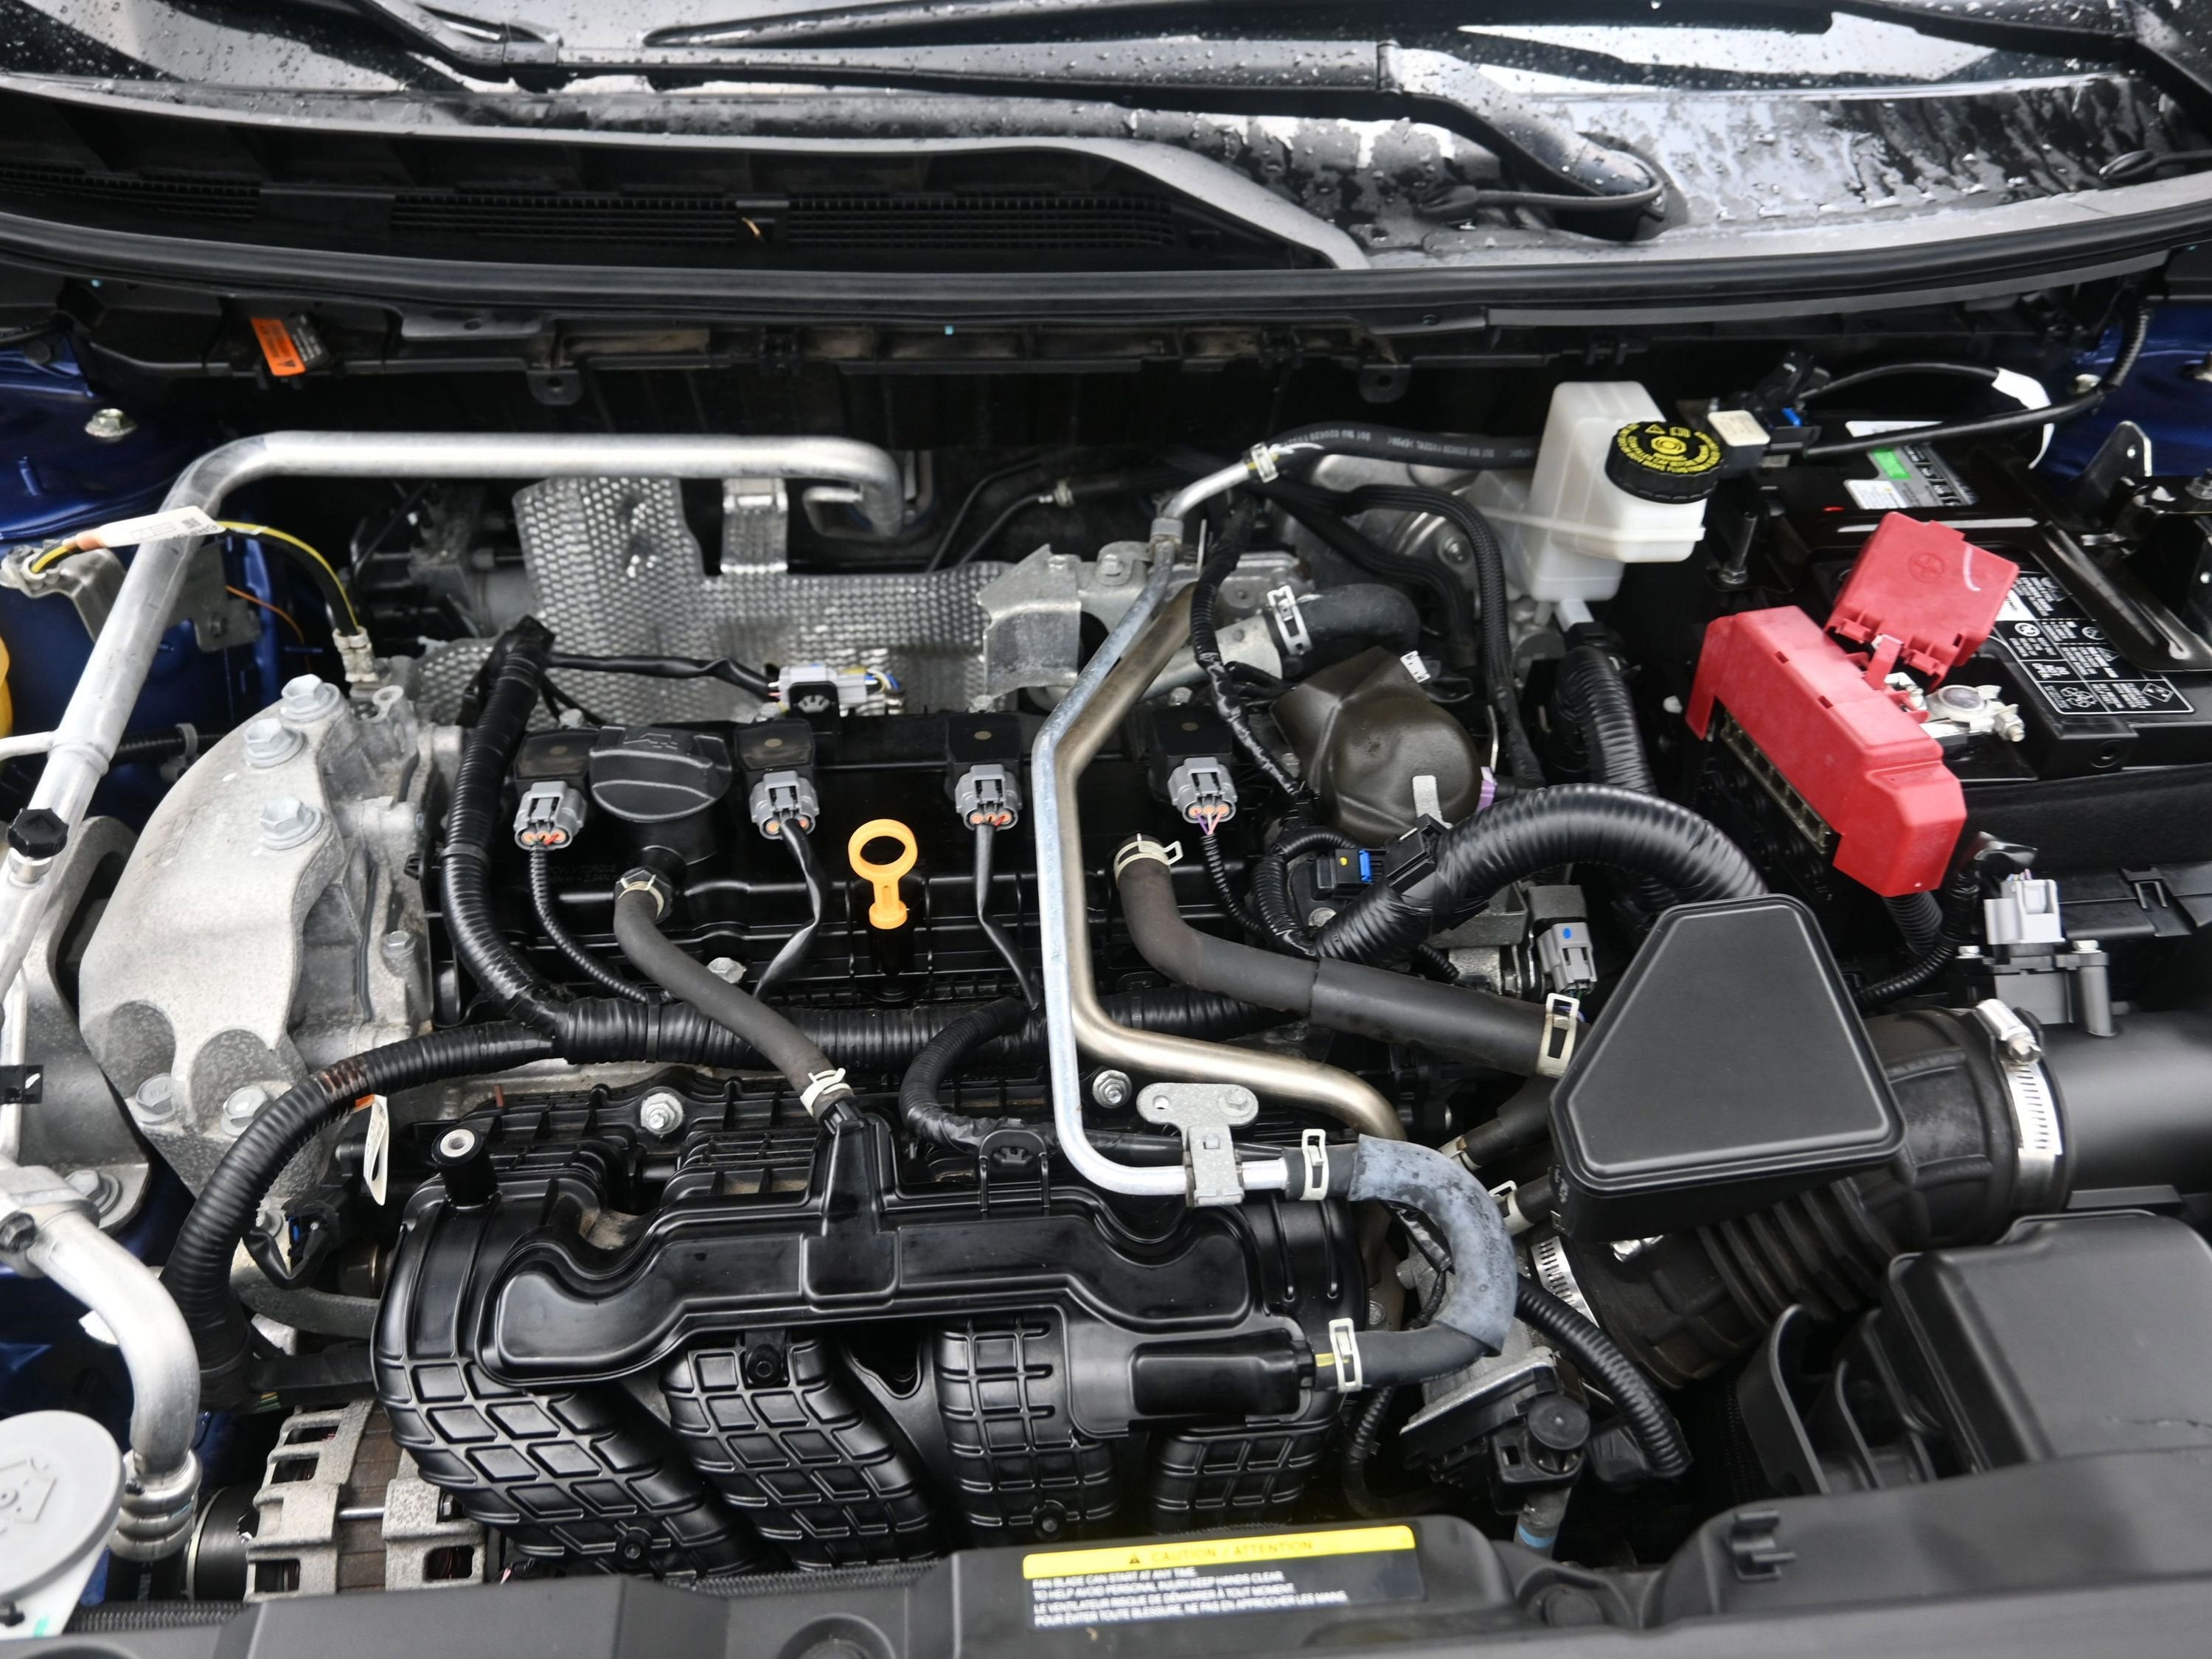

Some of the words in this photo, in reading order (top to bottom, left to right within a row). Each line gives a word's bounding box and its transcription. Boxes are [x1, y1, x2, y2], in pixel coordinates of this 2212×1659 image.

[1151, 1548, 1216, 1563] CAUTION
[1234, 1540, 1313, 1557] ATTENTION
[1034, 1590, 1048, 1601] TO
[1048, 1587, 1074, 1600] HELP
[1074, 1585, 1105, 1599] AVOID
[1105, 1582, 1158, 1596] PERSONAL
[1190, 1576, 1216, 1590] KEEP
[1216, 1573, 1251, 1586] HANDS
[1053, 1576, 1085, 1588] BLADE
[1085, 1574, 1107, 1586] CAN
[1108, 1571, 1138, 1585] START
[1138, 1570, 1152, 1582] AT
[1152, 1568, 1172, 1580] ANY
[1034, 1602, 1047, 1615] LE
[1047, 1597, 1110, 1613] VENTILATEUR
[1110, 1594, 1148, 1608] RISQUE
[1147, 1593, 1163, 1605] DE
[1225, 1586, 1251, 1599] TOUT
[1034, 1614, 1065, 1627] POUR
[1099, 1607, 1130, 1621] TOUTE
[1184, 1601, 1200, 1615] NE
[1199, 1600, 1220, 1613] PAS
[1220, 1599, 1236, 1611] EN
[1235, 1594, 1296, 1610] APPROCHER
[1295, 1592, 1315, 1605] LES
